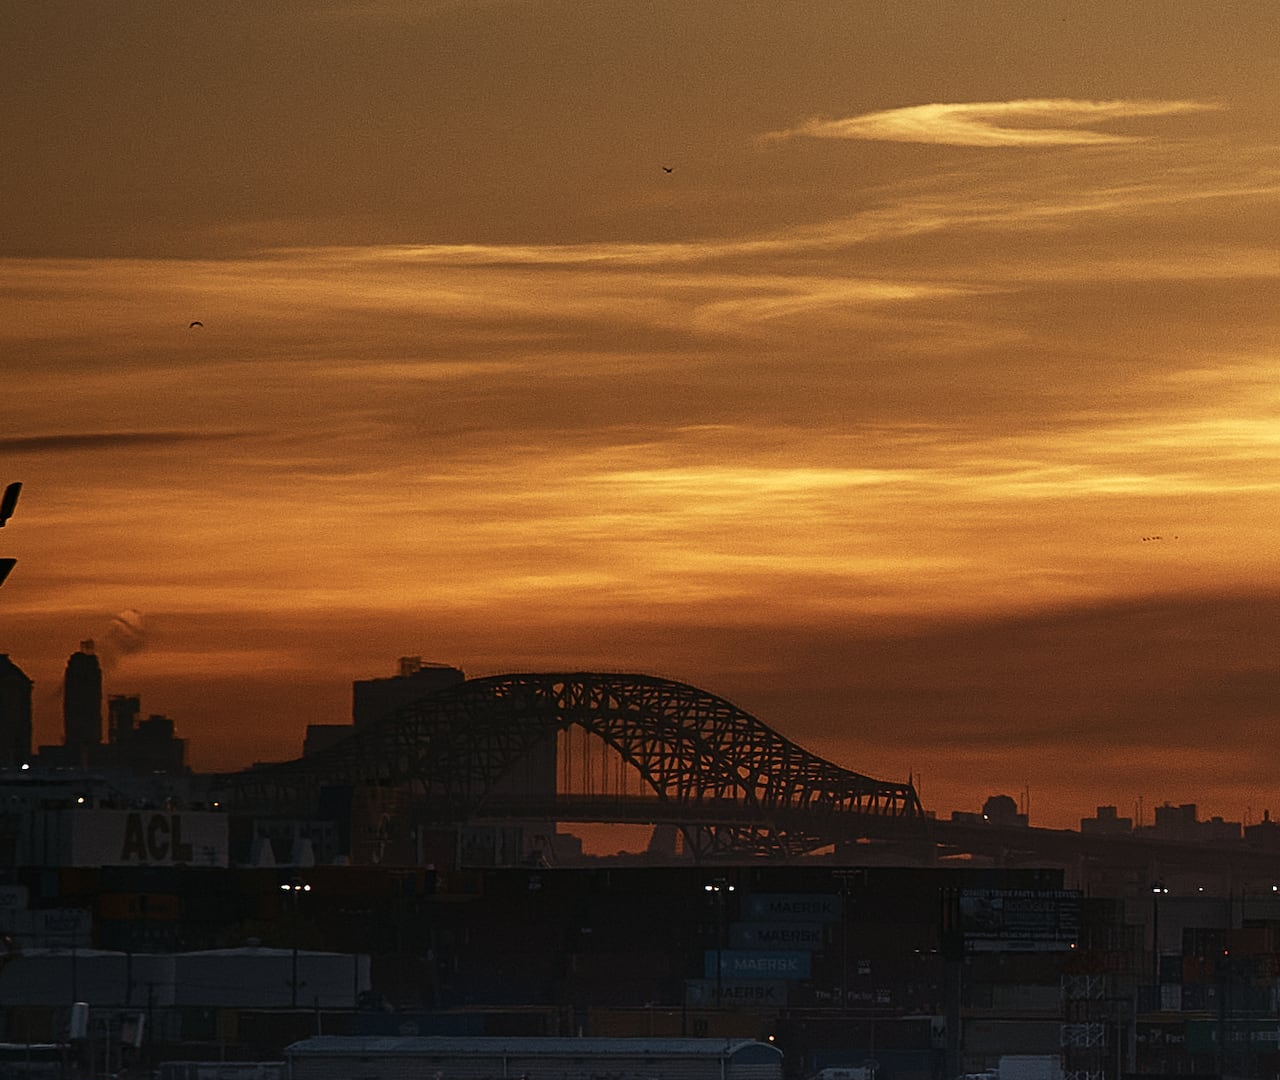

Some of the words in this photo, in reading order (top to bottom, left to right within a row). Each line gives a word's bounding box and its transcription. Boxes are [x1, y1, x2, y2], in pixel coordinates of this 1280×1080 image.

[121, 813, 193, 861] ACL
[769, 902, 832, 914] MAERSK
[758, 930, 820, 942] MAERSK
[733, 959, 798, 971] MAERSK
[711, 986, 775, 998] MAERSK
